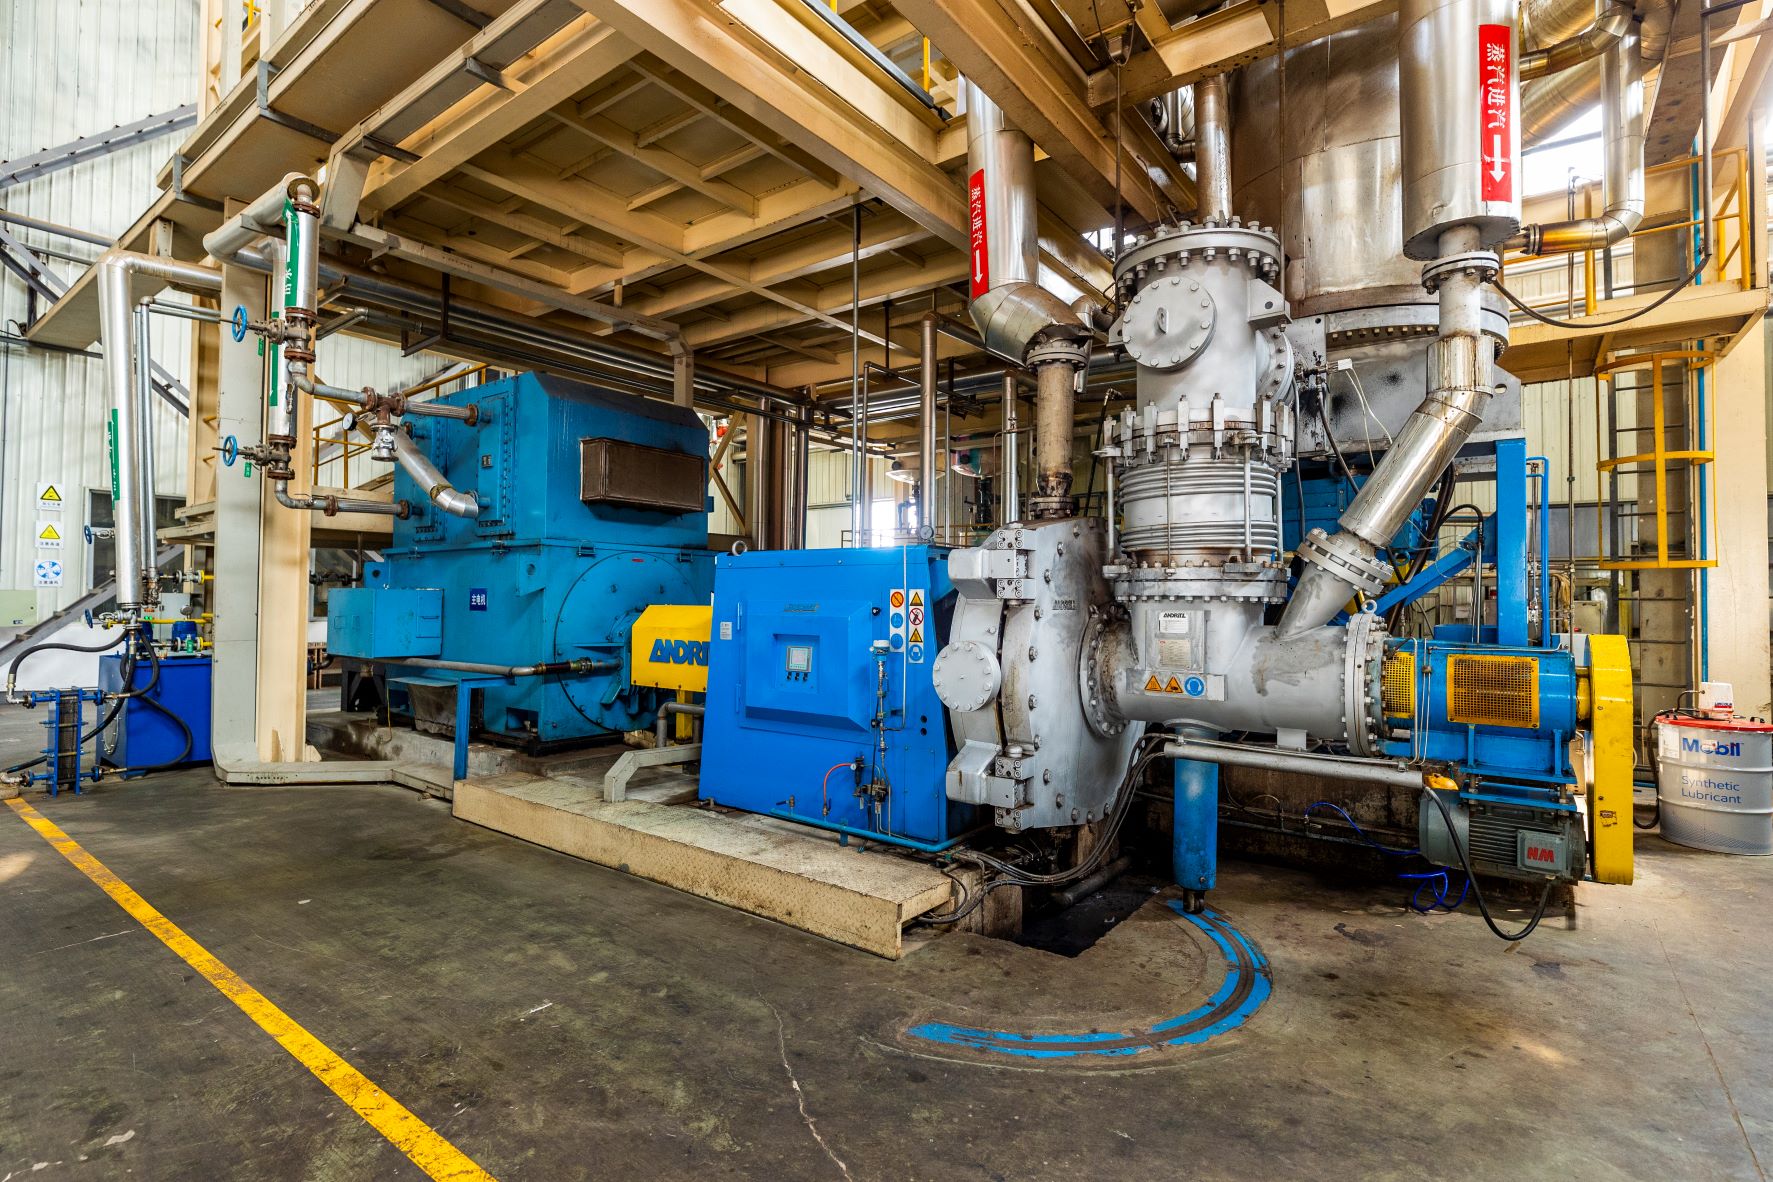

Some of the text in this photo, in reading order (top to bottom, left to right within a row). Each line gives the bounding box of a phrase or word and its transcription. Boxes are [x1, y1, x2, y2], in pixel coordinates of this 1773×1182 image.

[1487, 43, 1506, 128] 蒸汽进汽
[471, 593, 486, 606] 主电机
[649, 639, 710, 666] ANDRI
[1682, 775, 1740, 792] Synthetic
[1682, 788, 1742, 804] Lubricant
